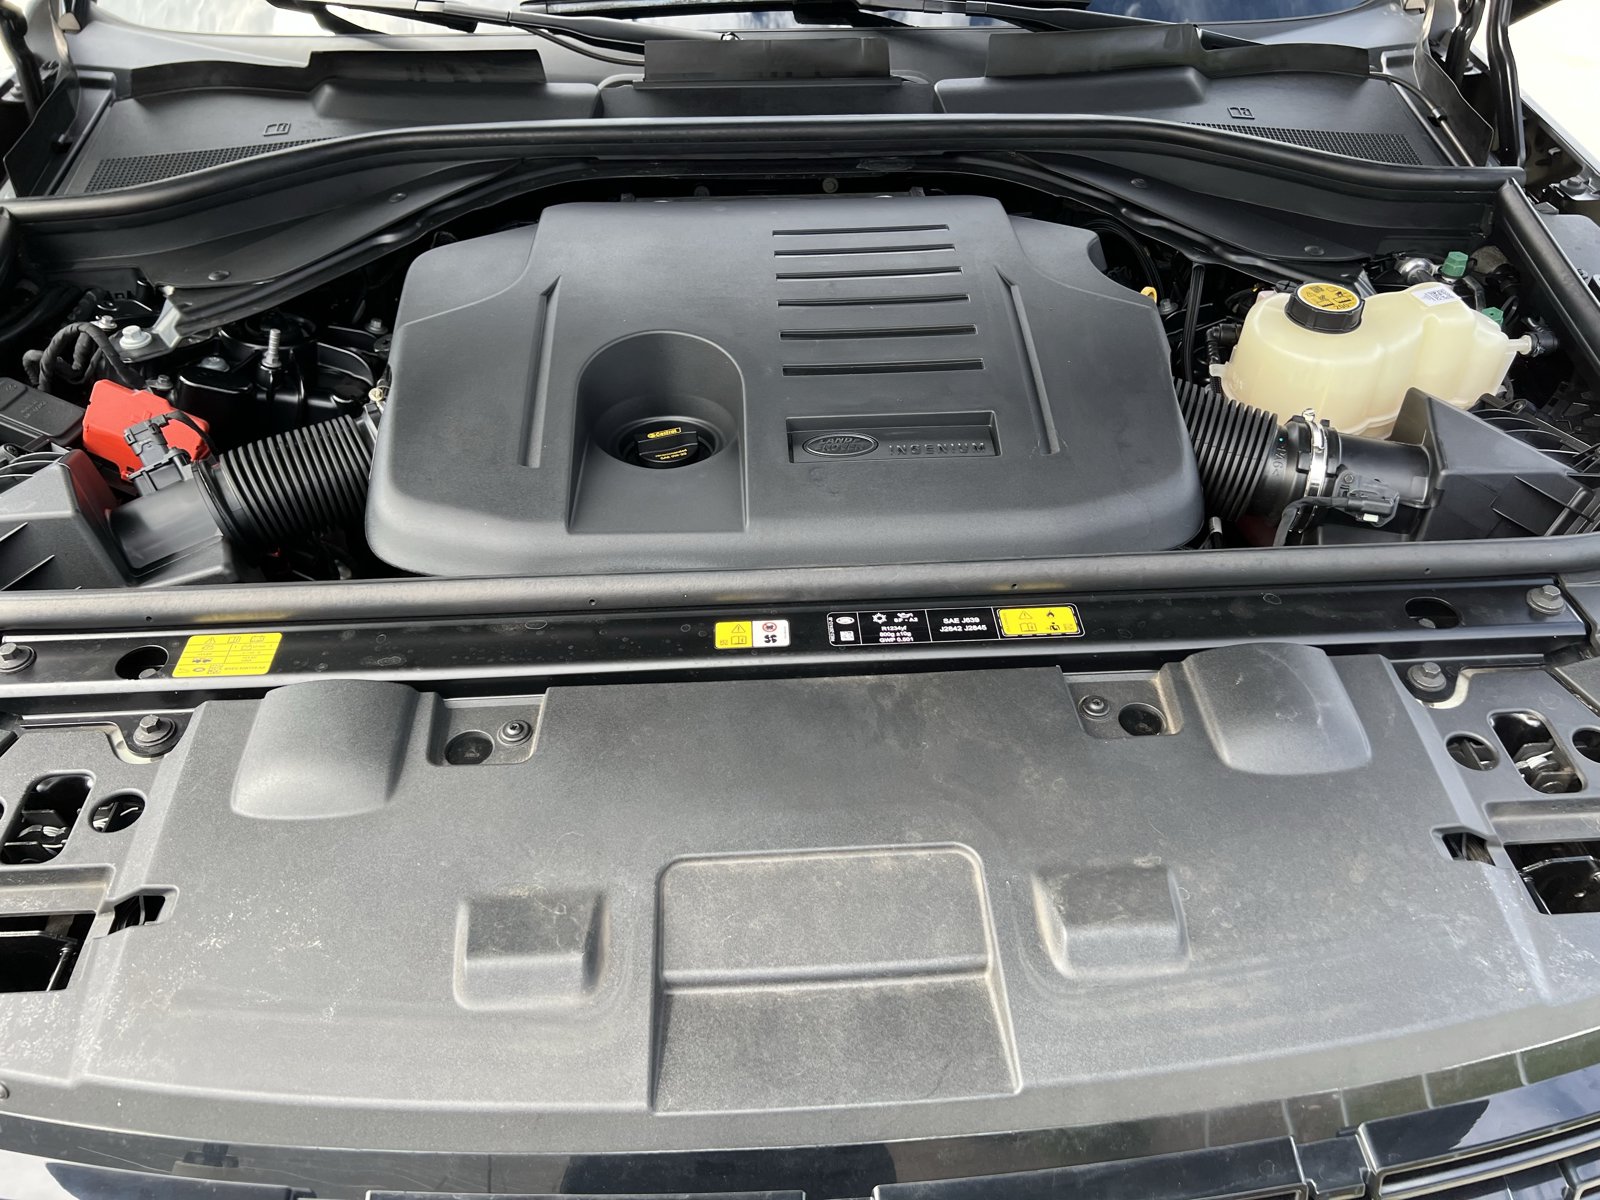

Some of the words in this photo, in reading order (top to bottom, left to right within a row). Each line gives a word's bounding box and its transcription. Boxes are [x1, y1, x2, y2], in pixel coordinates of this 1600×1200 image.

[655, 428, 678, 437] Castrol
[820, 437, 854, 445] LAND
[888, 442, 986, 456] INGENIUM
[961, 616, 980, 624] J639
